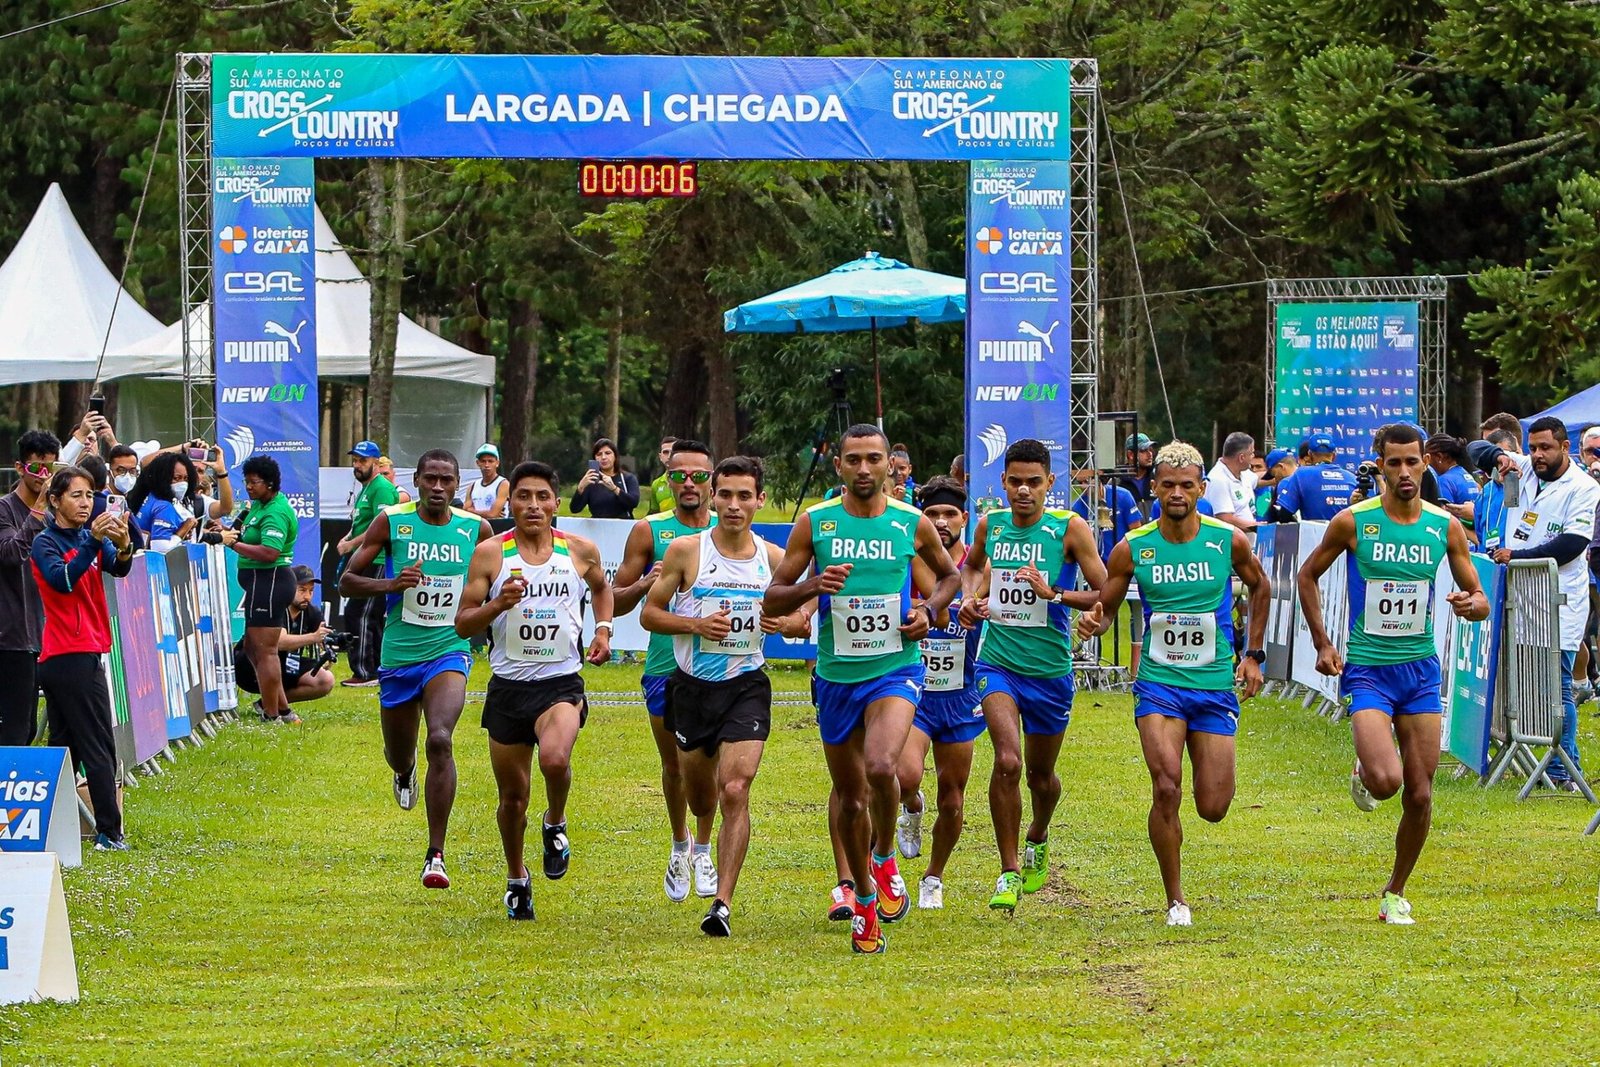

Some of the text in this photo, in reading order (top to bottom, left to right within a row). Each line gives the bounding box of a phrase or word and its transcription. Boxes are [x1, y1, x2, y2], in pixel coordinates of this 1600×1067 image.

[230, 69, 344, 78] CAMPEONATO
[894, 70, 1005, 79] CAMPEONATO
[230, 79, 250, 88] SUL
[260, 79, 325, 88] AMERICANO
[328, 79, 341, 88] de
[894, 80, 913, 89] SUL
[923, 80, 987, 89] AMERICANO
[990, 80, 1003, 89] de
[228, 91, 306, 119] CROSS
[446, 94, 630, 123] LARGADA
[663, 94, 847, 123] CHEGADA
[892, 92, 969, 120] CROSS
[291, 110, 399, 139] COUNTRY
[955, 111, 1058, 140] COUNTRY
[294, 140, 395, 149] Poços de Caldas
[958, 140, 1055, 149] Poços de Caldas
[215, 177, 260, 193] CROSS
[583, 165, 694, 193] 00:00:06
[973, 179, 1016, 194] CROSS
[251, 188, 311, 204] COUNTRY
[1008, 190, 1065, 205] COUNTRY
[253, 226, 308, 239] loterias
[1008, 228, 1062, 240] loterias
[253, 240, 309, 254] CAIXA
[1008, 242, 1063, 255] CAIXA
[224, 271, 304, 293] CBAt
[980, 272, 1058, 293] CBAt
[1316, 316, 1328, 330] OS
[1330, 316, 1378, 330] MELHORES
[1316, 331, 1378, 351] ESTÃO AQUI!
[224, 341, 289, 363] PUMA
[979, 341, 1043, 361] PUMA
[407, 542, 463, 563] BRASIL
[831, 538, 896, 560] BRASIL
[992, 542, 1046, 562] BRASIL
[1372, 542, 1434, 565] BRASIL
[1152, 561, 1215, 584] BRASIL
[522, 582, 570, 598] OLIVIA
[712, 581, 761, 590] ARGENTINA
[416, 591, 453, 607] 012
[999, 588, 1036, 605] 009
[1379, 599, 1417, 615] 011
[730, 616, 755, 633] 04
[846, 614, 890, 633] 033
[519, 624, 560, 641] 007
[1164, 630, 1204, 646] 018
